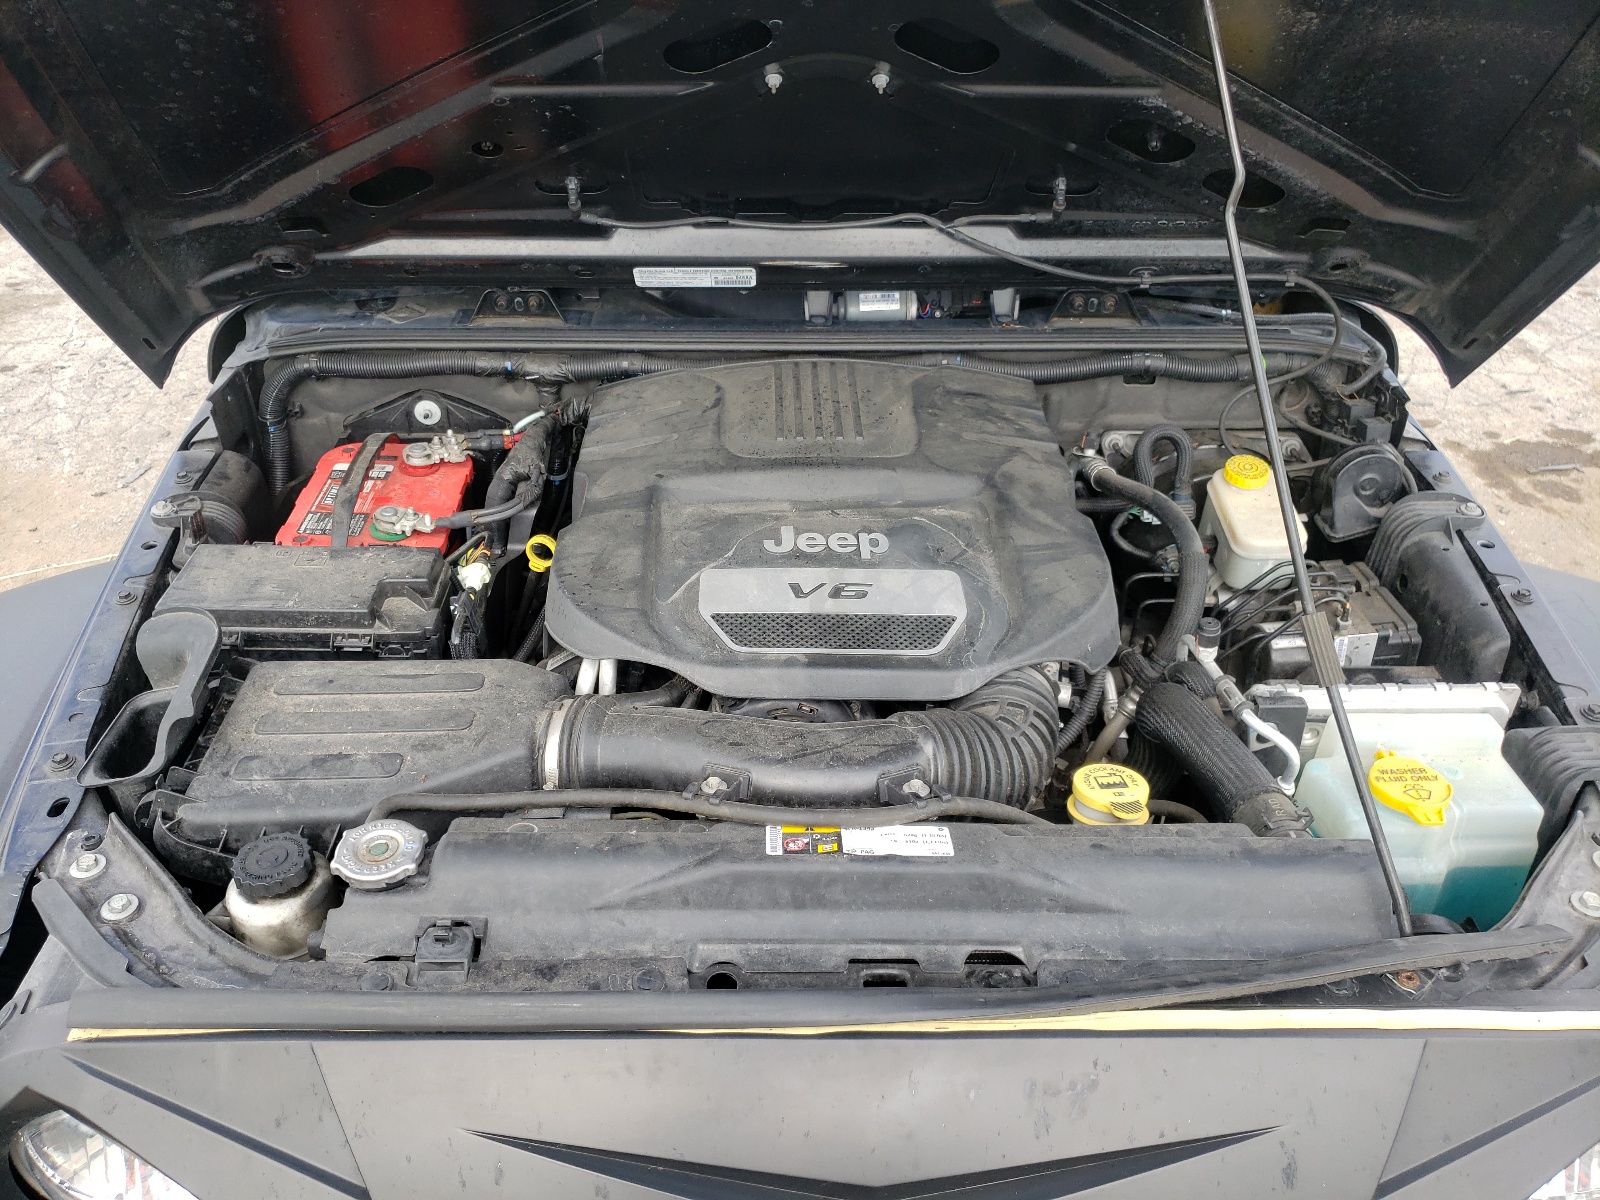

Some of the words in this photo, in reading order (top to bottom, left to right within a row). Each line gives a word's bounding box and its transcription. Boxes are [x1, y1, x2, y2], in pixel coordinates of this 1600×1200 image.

[763, 525, 890, 560] Jeep
[787, 582, 873, 600] V6
[1089, 766, 1126, 774] COOLANT
[1126, 773, 1139, 787] ONLY
[1375, 775, 1407, 783] FLUID
[1410, 774, 1439, 782] ONLY
[1377, 767, 1427, 775] WASHER
[1268, 798, 1287, 817] RAD
